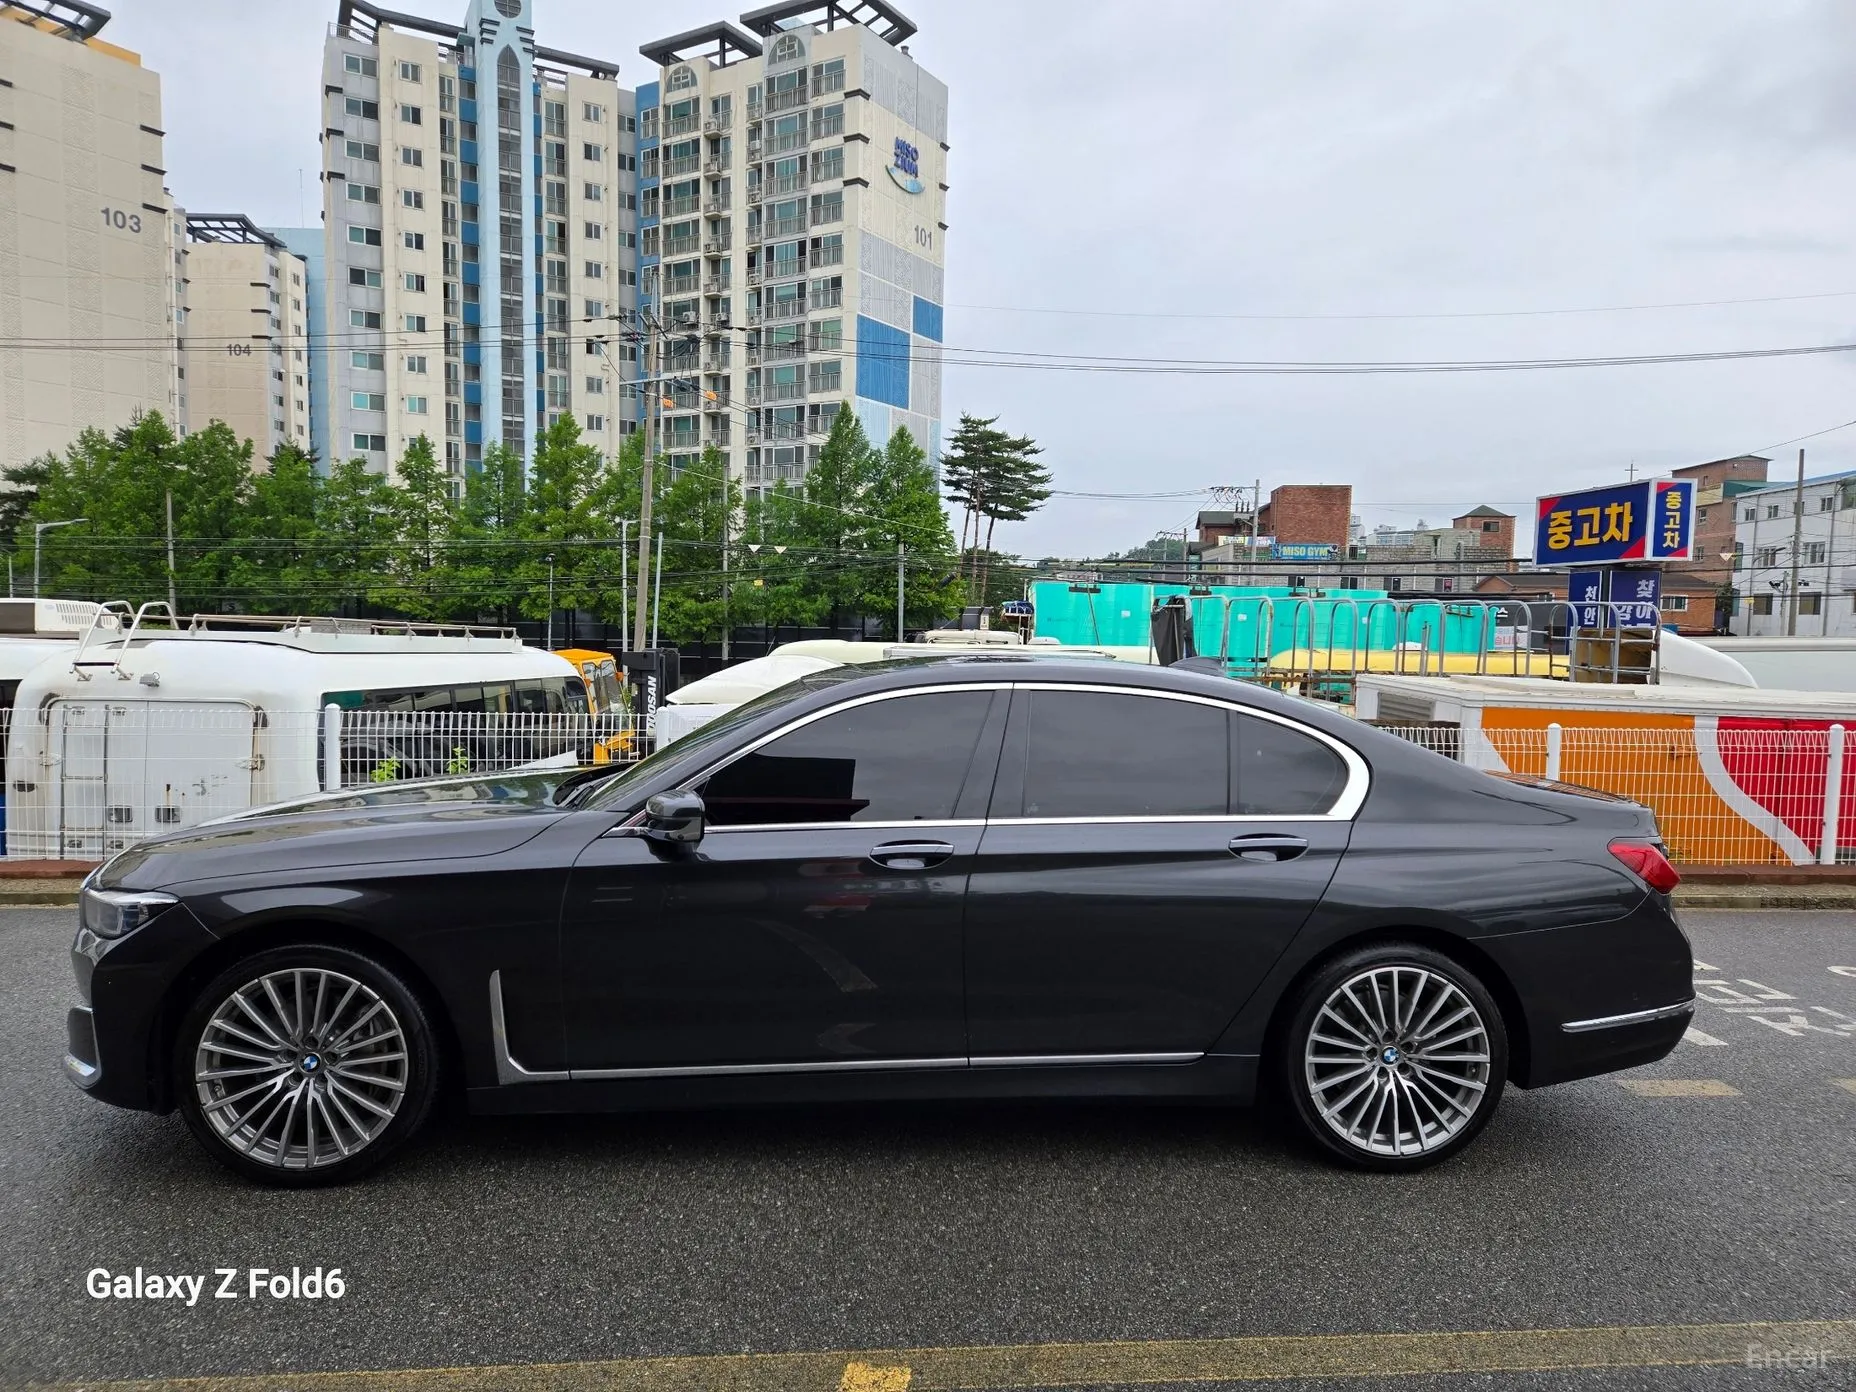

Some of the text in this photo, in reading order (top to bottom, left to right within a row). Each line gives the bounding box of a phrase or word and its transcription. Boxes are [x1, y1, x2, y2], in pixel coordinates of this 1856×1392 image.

[100, 207, 142, 234] 103
[914, 225, 933, 250] 101
[227, 343, 252, 357] 104
[1547, 501, 1633, 550] 중고차
[1662, 491, 1682, 549] 중고차
[1282, 545, 1329, 556] MISO GYM
